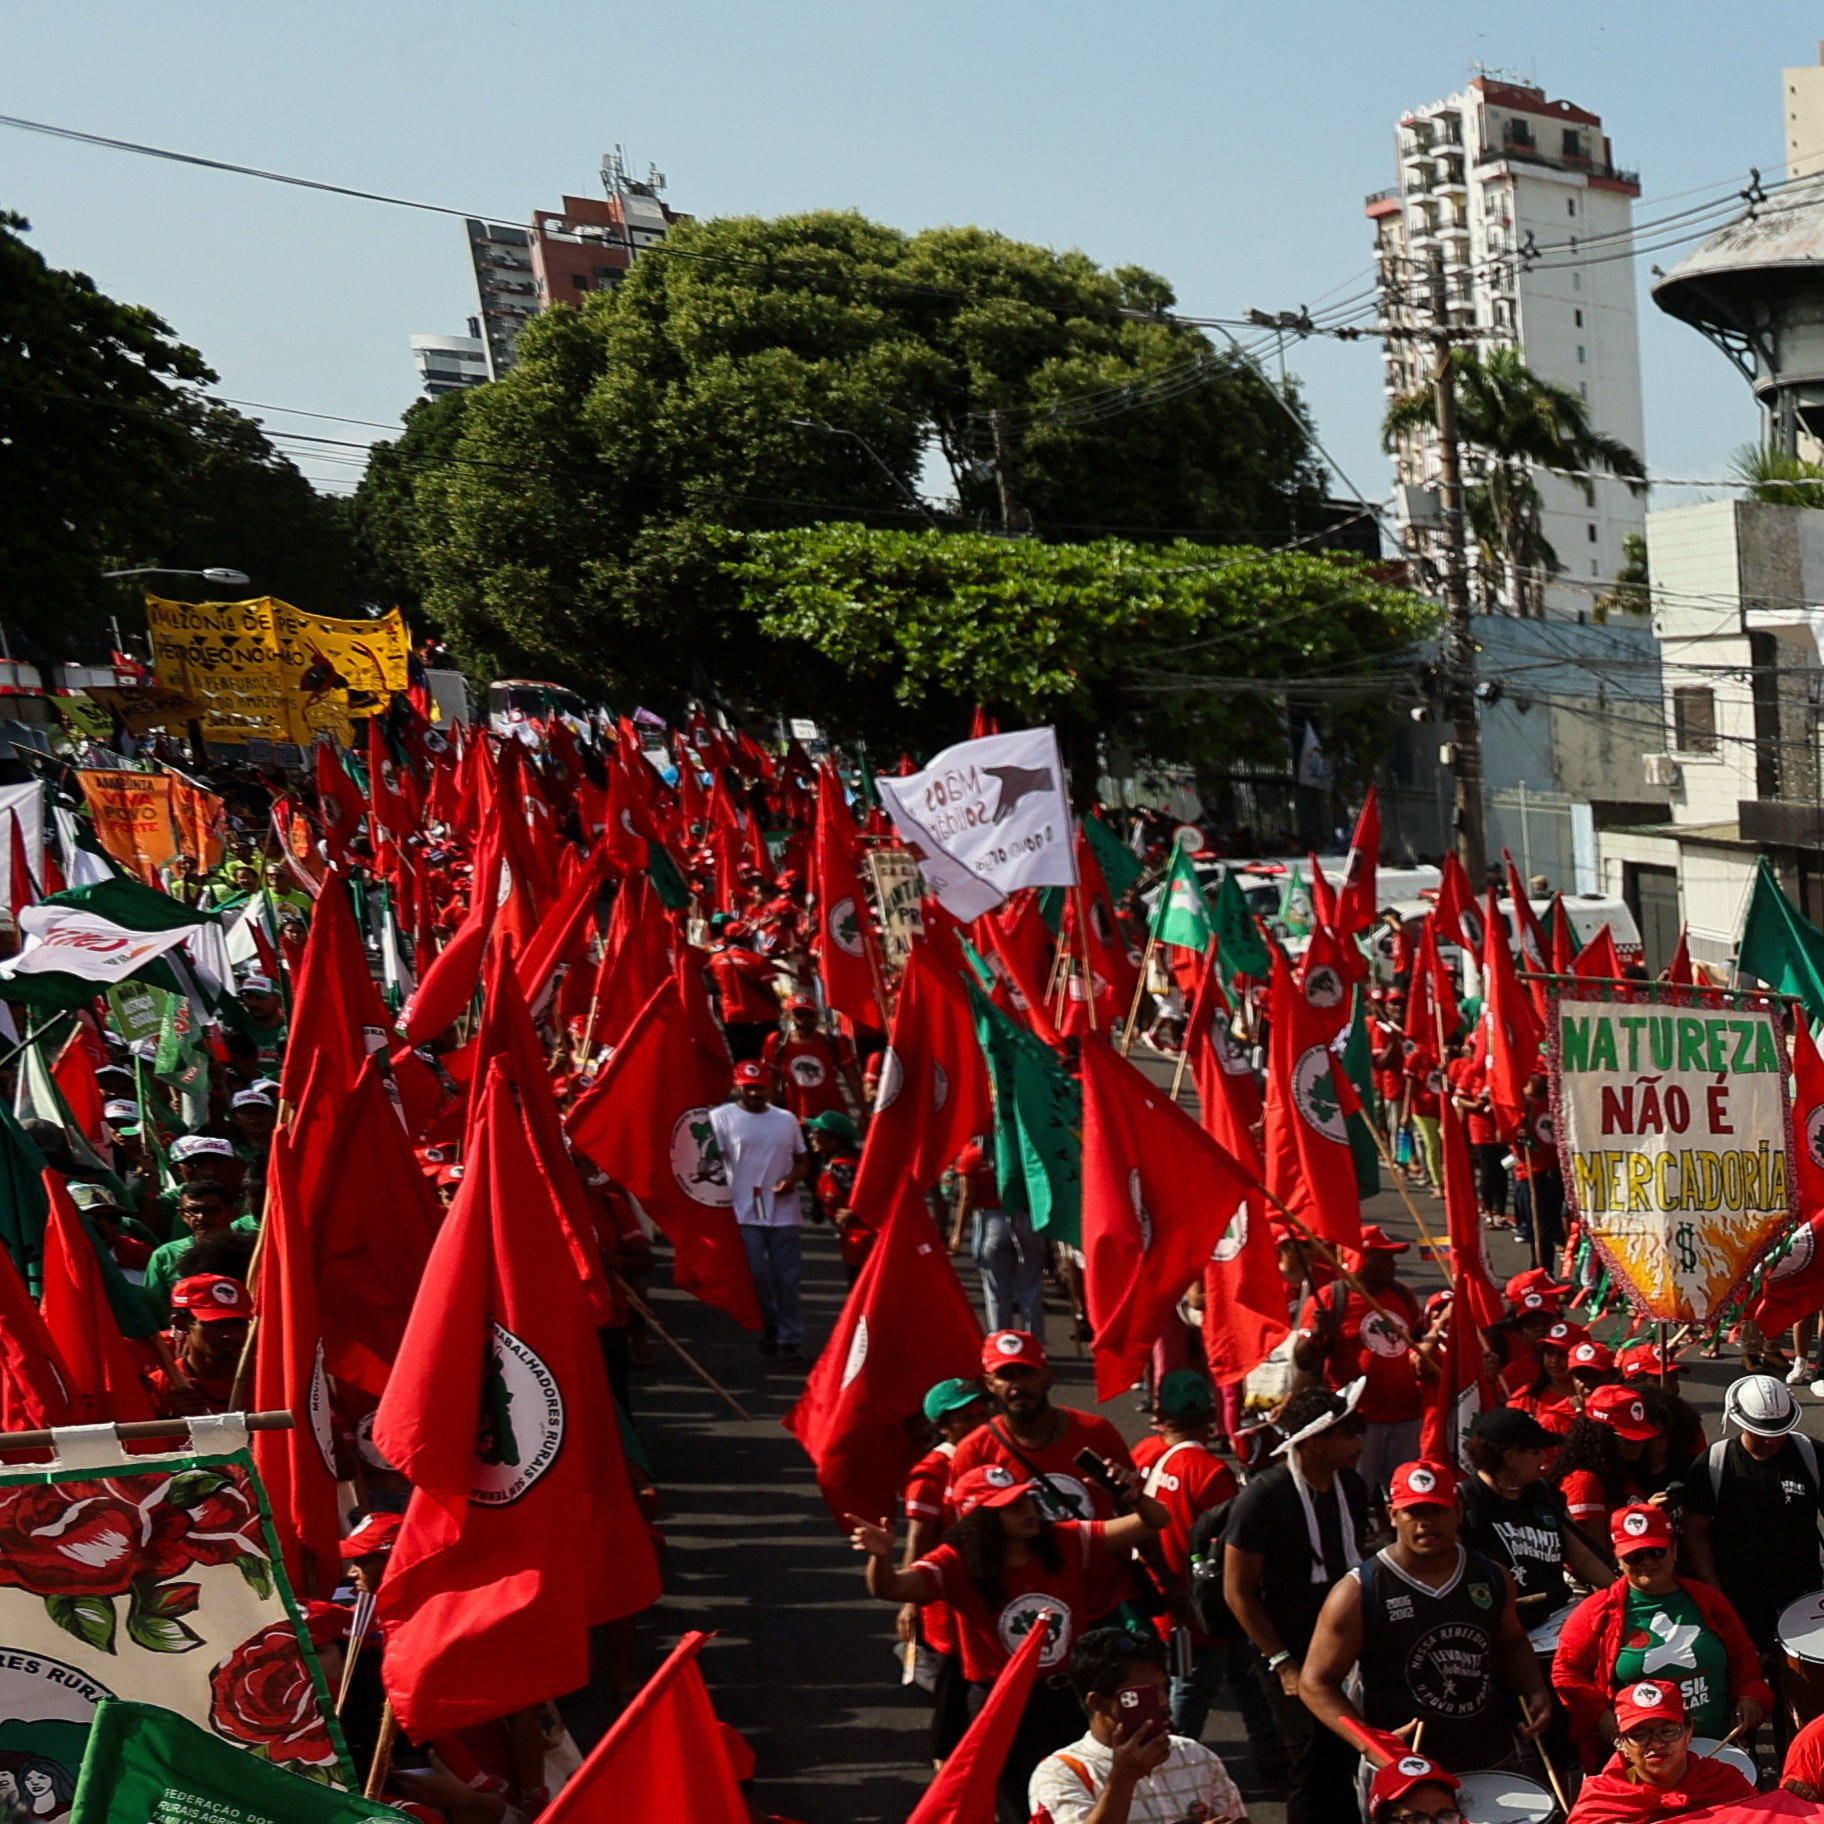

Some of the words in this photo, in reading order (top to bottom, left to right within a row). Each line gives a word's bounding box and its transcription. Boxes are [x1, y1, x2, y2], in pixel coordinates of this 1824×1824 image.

[244, 614, 271, 632] DE
[101, 791, 151, 806] VIVA
[104, 807, 157, 820] POVO
[1563, 1015, 1779, 1076] NATUREZA
[1602, 1073, 1692, 1135] NÃO
[1709, 1073, 1735, 1135] É
[495, 1327, 561, 1428] RABALHADORES
[1499, 1521, 1562, 1549] LEVANTE
[163, 1788, 241, 1819] FEDERAÇÃO
